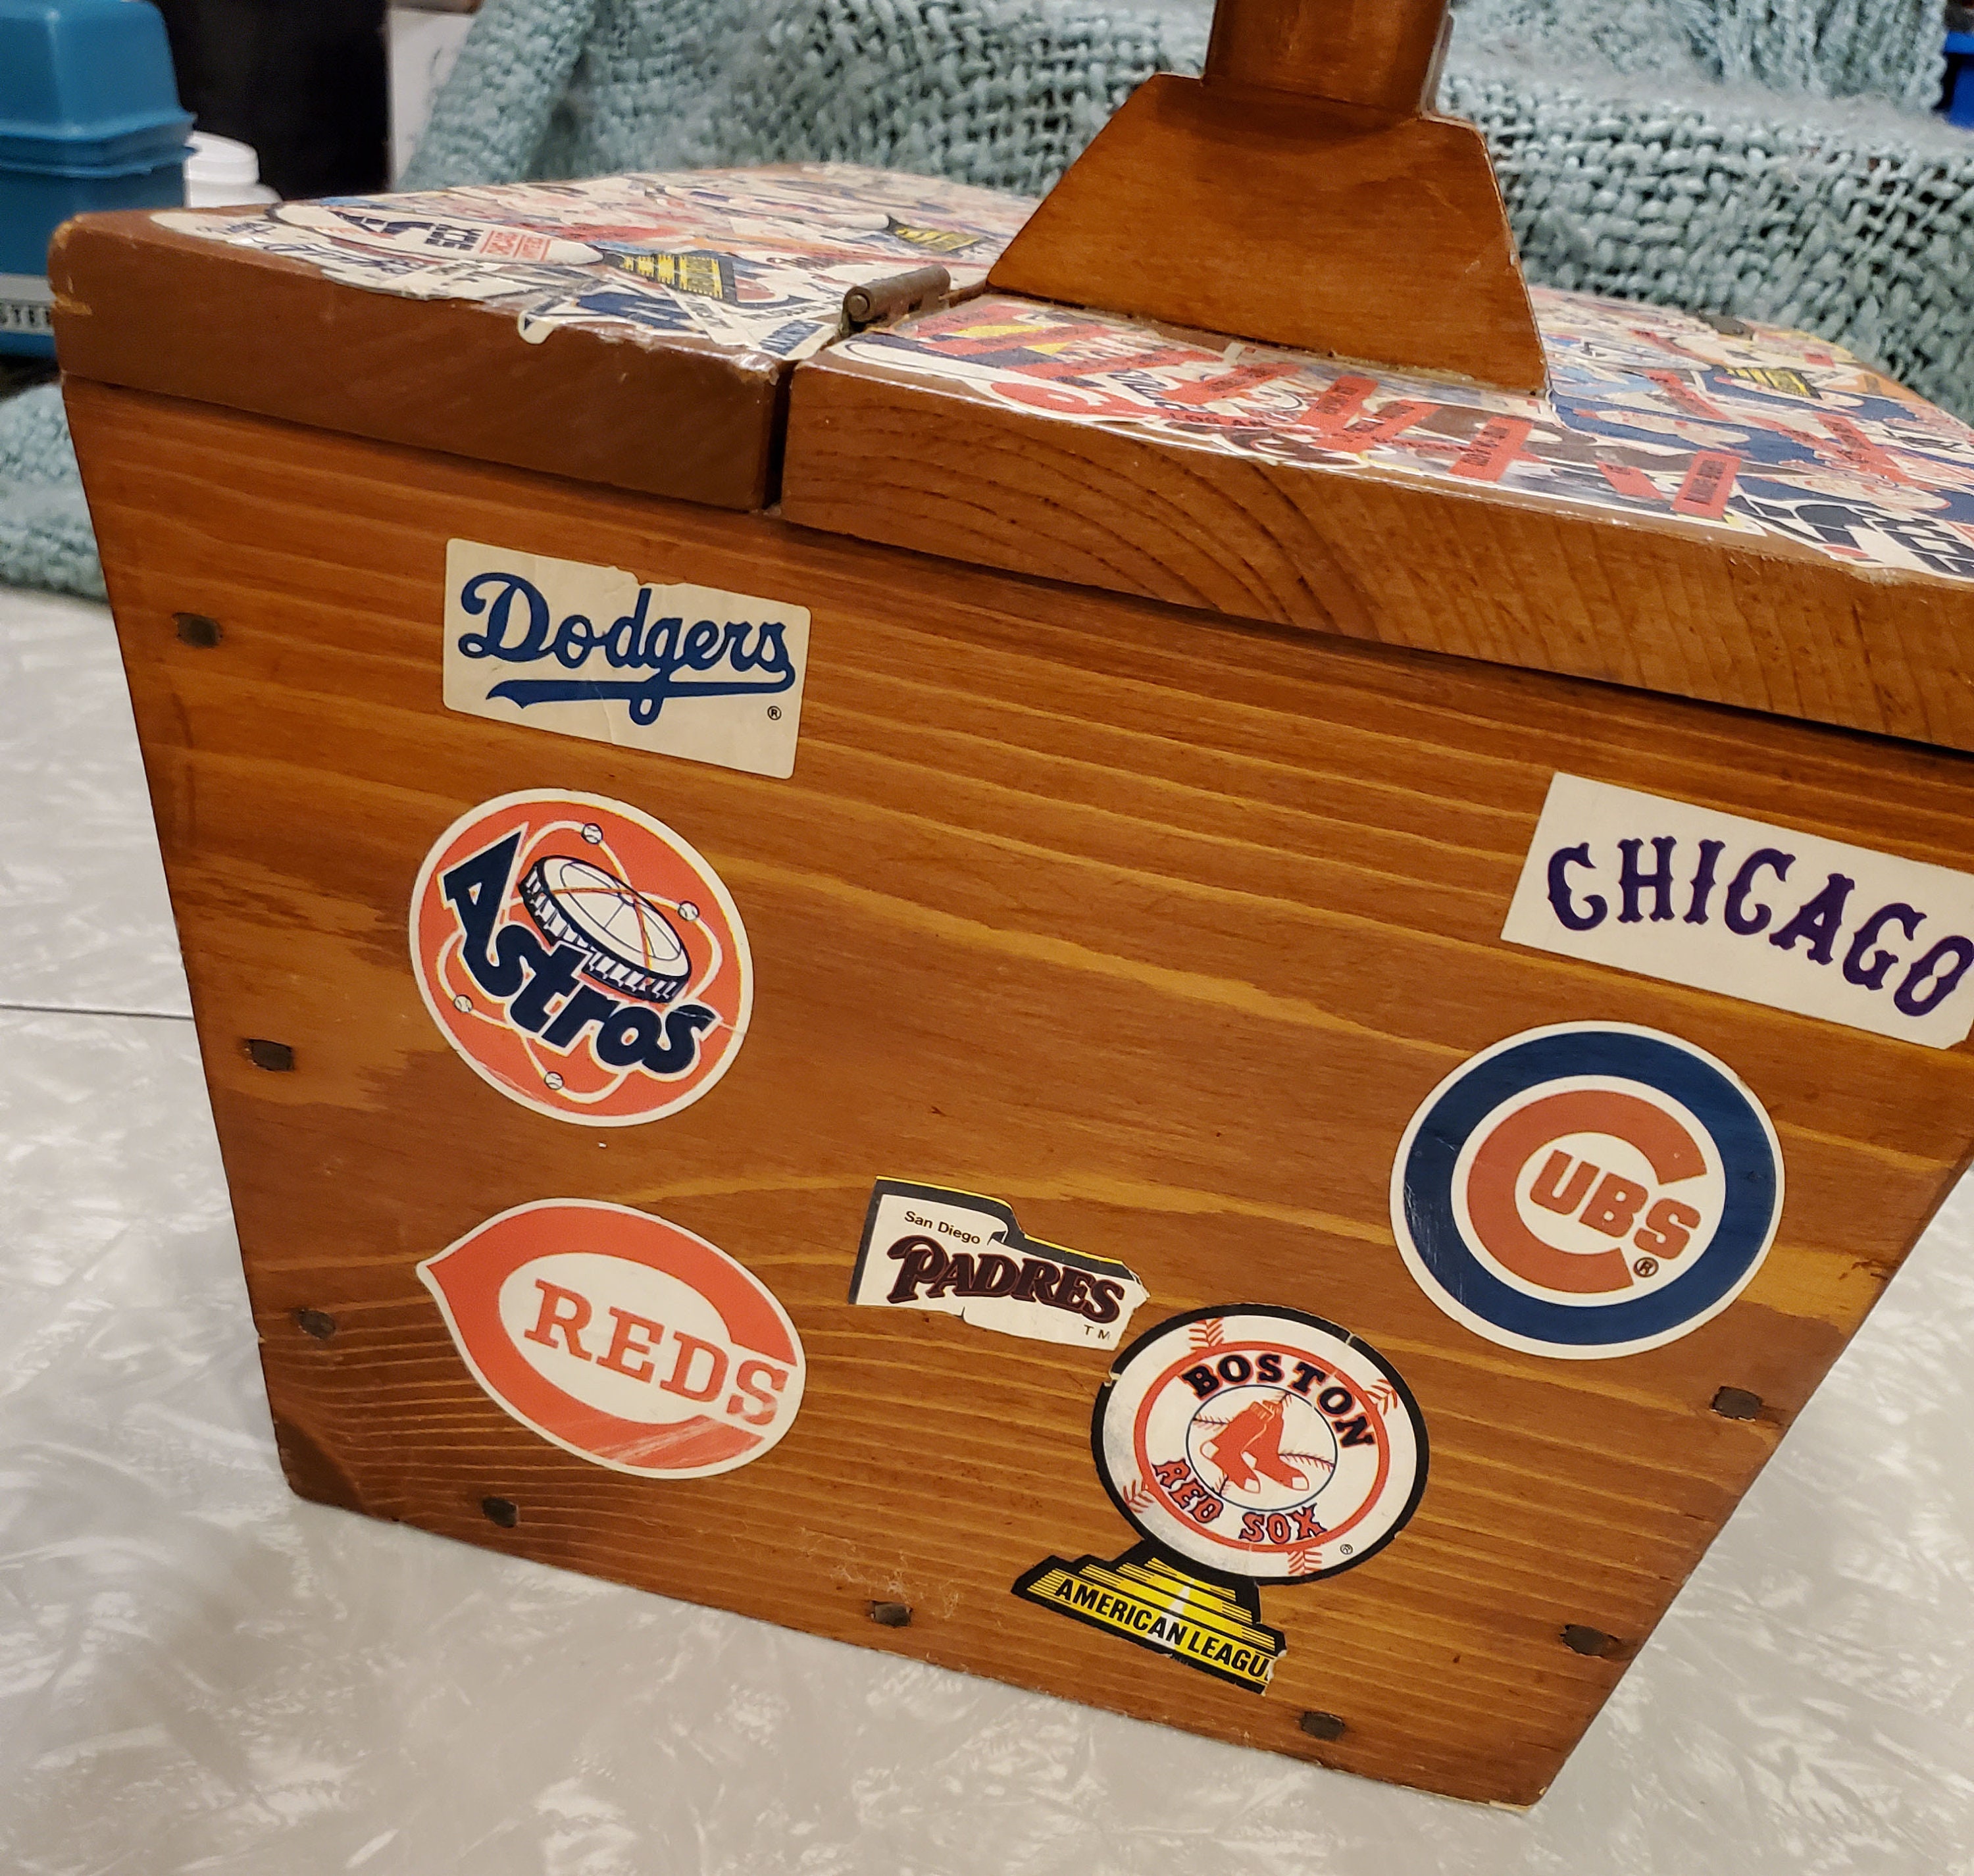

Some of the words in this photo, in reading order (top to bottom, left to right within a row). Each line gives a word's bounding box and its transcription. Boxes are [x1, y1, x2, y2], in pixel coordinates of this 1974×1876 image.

[459, 572, 796, 726] Dodgers
[442, 830, 717, 1074] Astros
[1548, 836, 1974, 1017] CHICAGO
[886, 1234, 1125, 1324] PADRES
[904, 1211, 933, 1229] San
[938, 1221, 981, 1245] Diego
[524, 1279, 789, 1426] REDS
[1178, 1353, 1377, 1448] BOSTON
[1152, 1458, 1225, 1525] RED
[1239, 1502, 1328, 1544] SOX
[1054, 1578, 1188, 1646] AMERICAN
[1188, 1631, 1270, 1681] LEAGU
